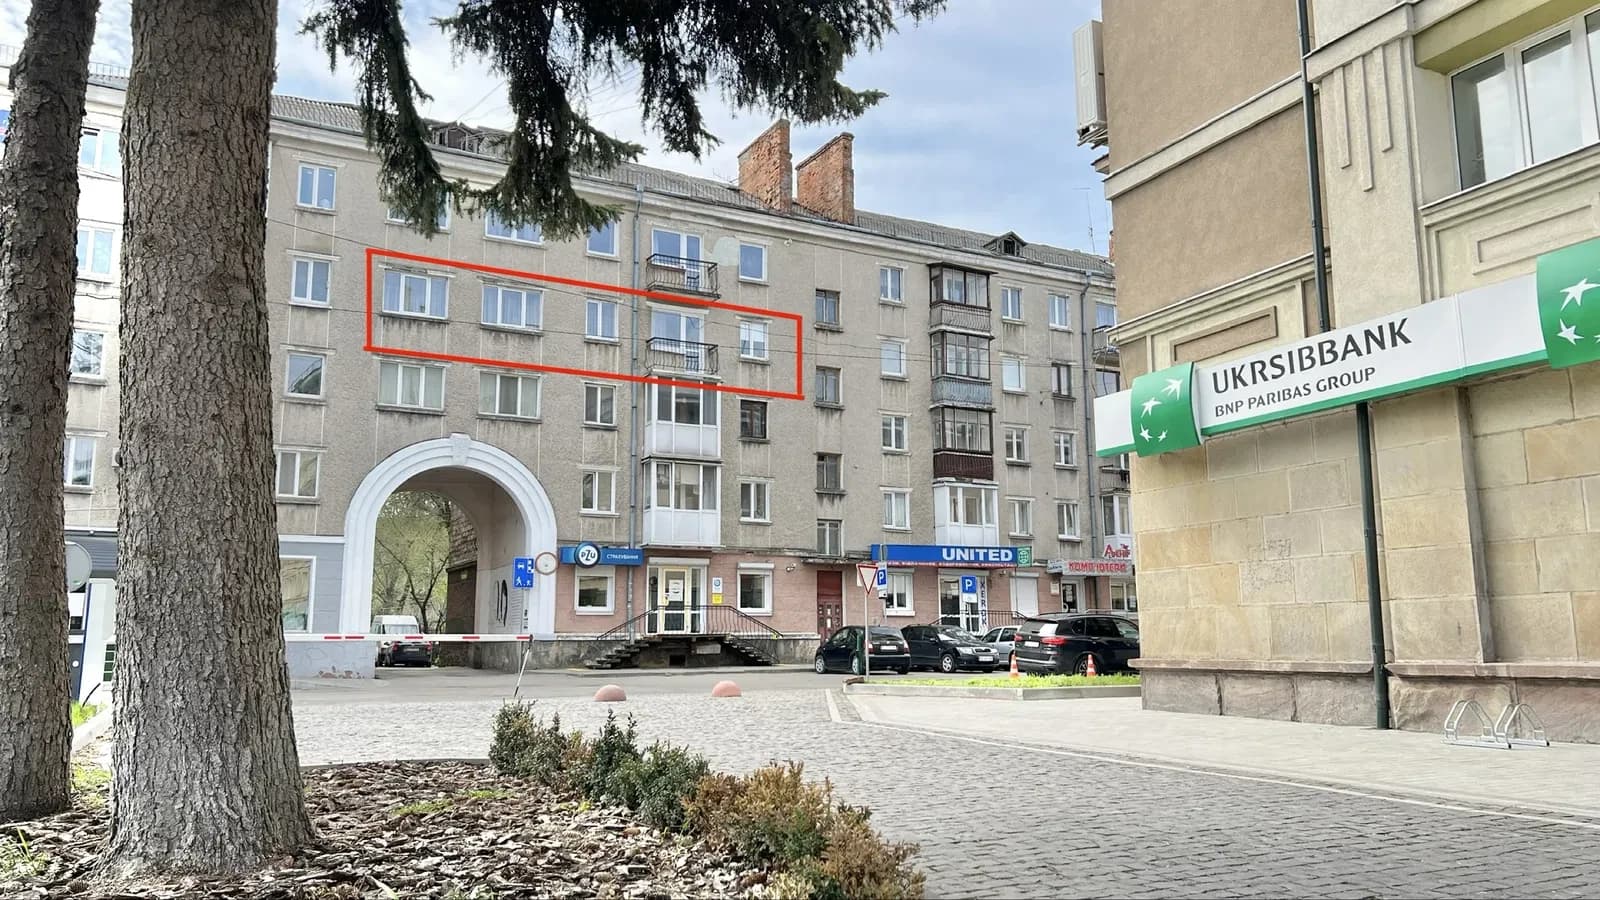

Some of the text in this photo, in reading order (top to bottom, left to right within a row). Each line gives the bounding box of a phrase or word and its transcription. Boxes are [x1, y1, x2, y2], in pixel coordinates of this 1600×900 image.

[1212, 317, 1412, 394] UKRSIBBANK
[1215, 366, 1376, 417] BNP PARIBAS GROUP
[942, 547, 1013, 562] UNITED
[878, 571, 885, 583] P
[965, 578, 973, 591] P
